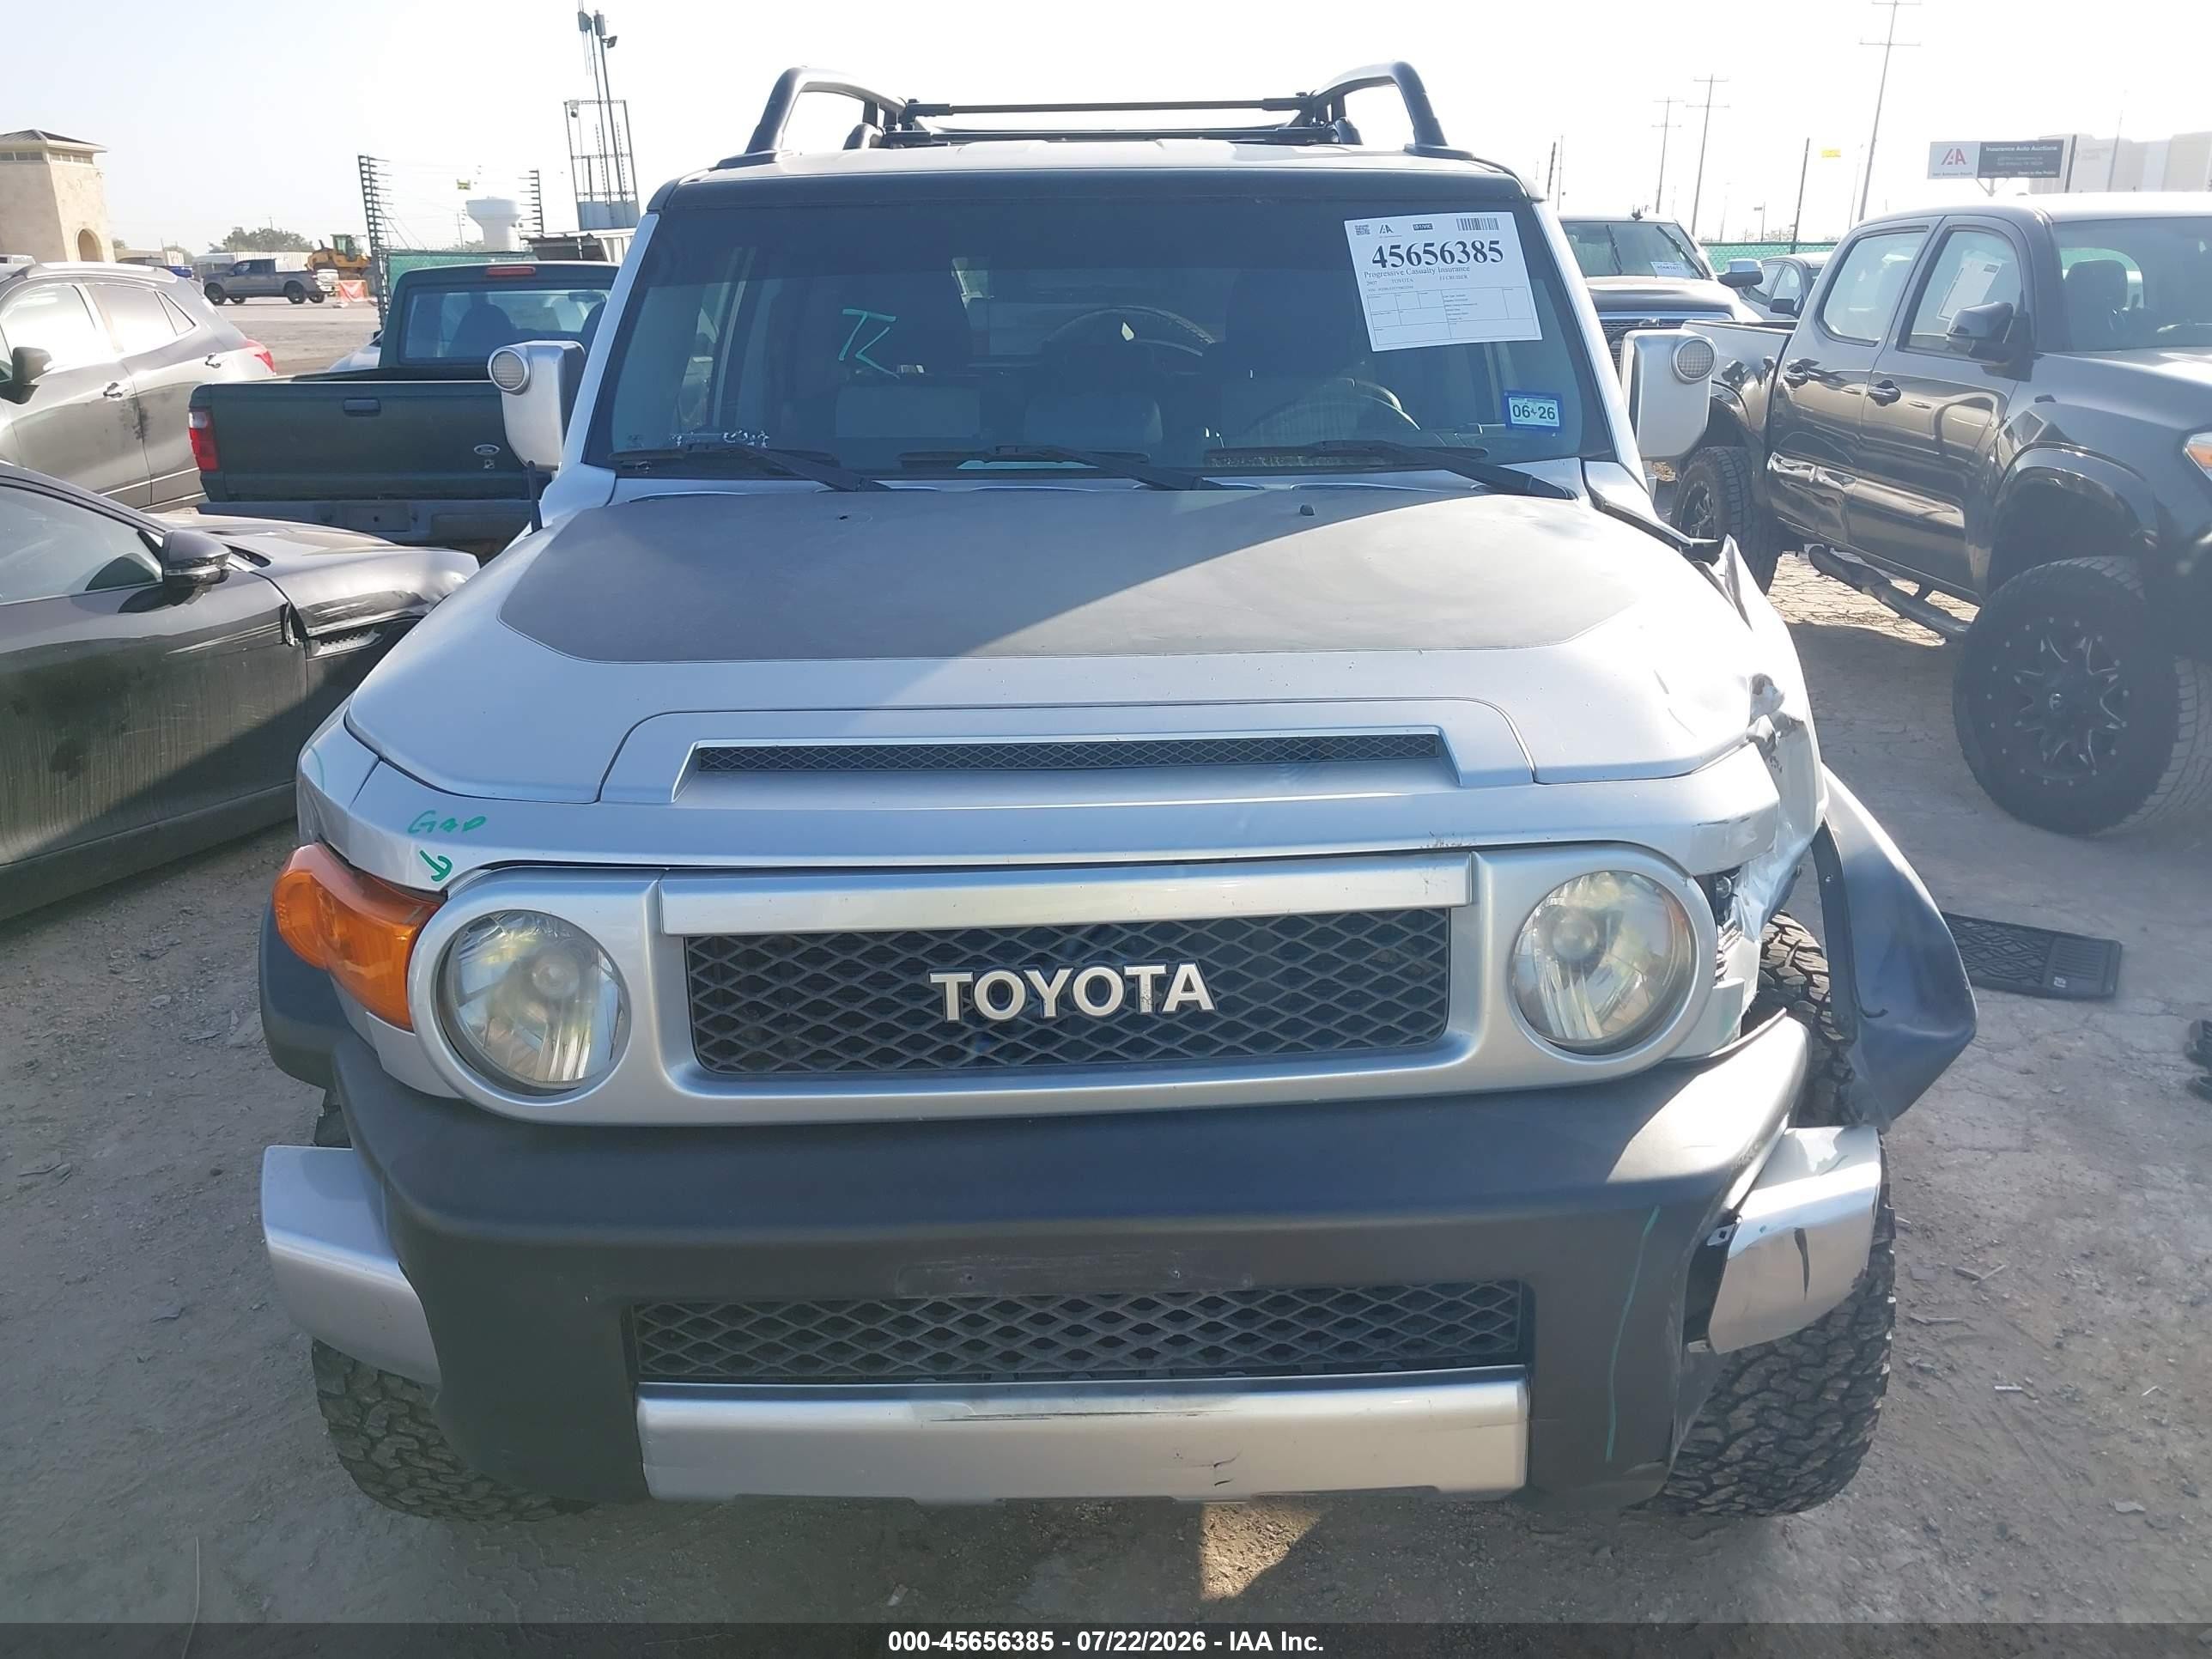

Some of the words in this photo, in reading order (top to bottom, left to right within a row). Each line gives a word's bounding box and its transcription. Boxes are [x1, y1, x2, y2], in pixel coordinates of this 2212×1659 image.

[1372, 240, 1504, 268] 45656385
[1364, 270, 1404, 279] Progressive
[929, 962, 1215, 1023] TOYOTA
